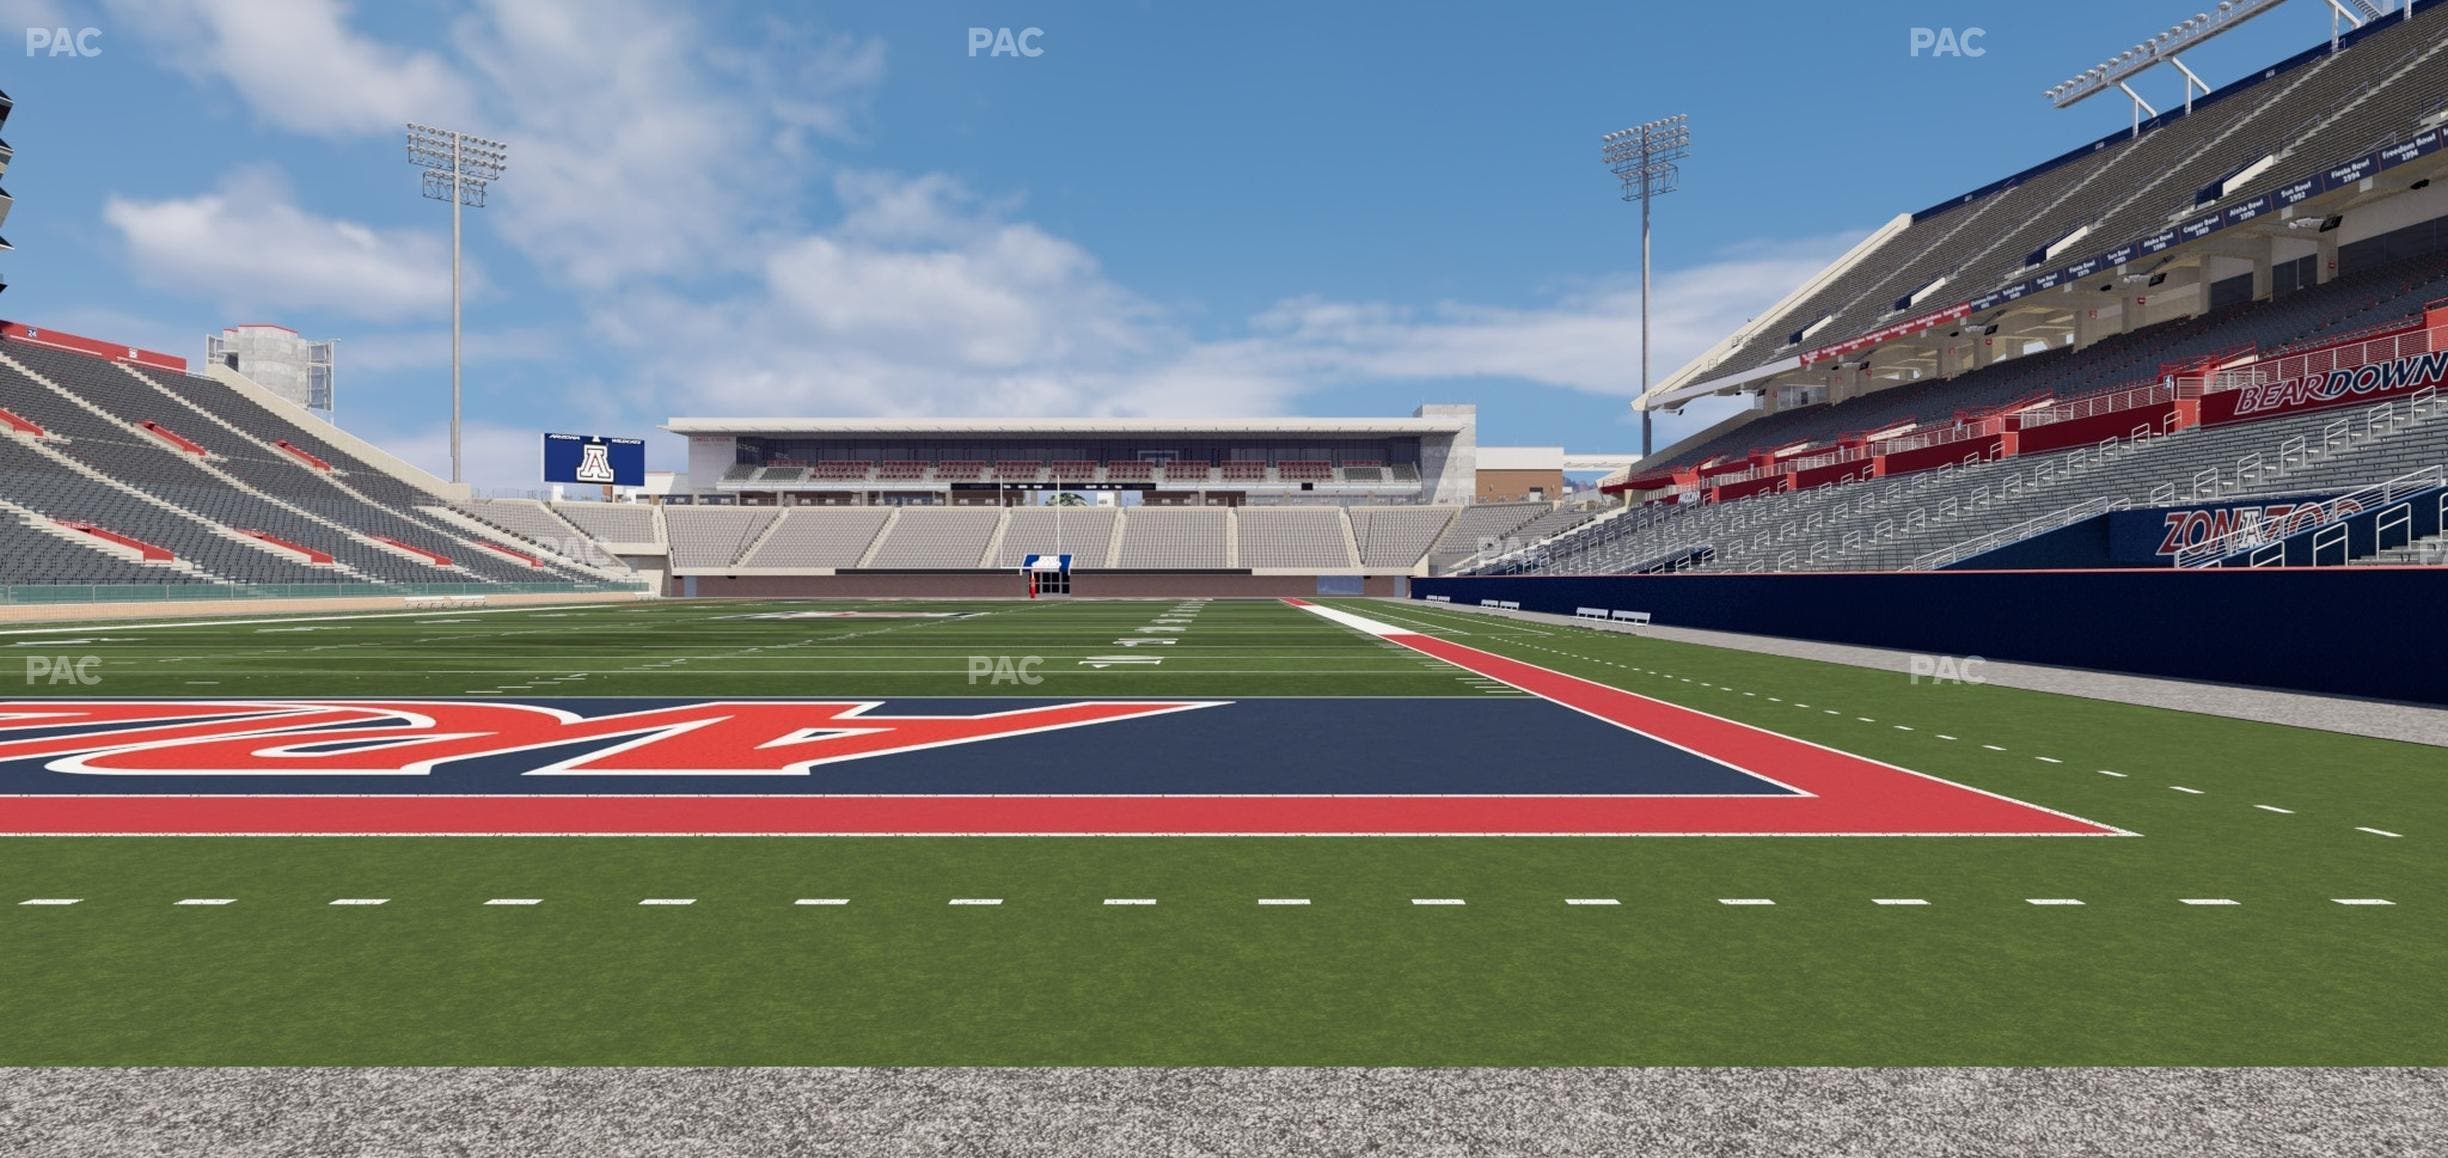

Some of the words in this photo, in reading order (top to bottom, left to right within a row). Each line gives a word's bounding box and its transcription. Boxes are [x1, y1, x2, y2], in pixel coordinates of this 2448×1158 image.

[2381, 140, 2415, 160] Freedom
[2415, 132, 2437, 148] Bowl
[2330, 166, 2351, 179] Fiesta
[2351, 158, 2370, 170] Bowl
[2280, 188, 2295, 198] Sun
[2294, 181, 2312, 193] Bowl
[2229, 205, 2248, 217] Aloha
[2247, 198, 2264, 210] Bowl
[2203, 215, 2219, 226] Bowl
[576, 444, 614, 483] A
